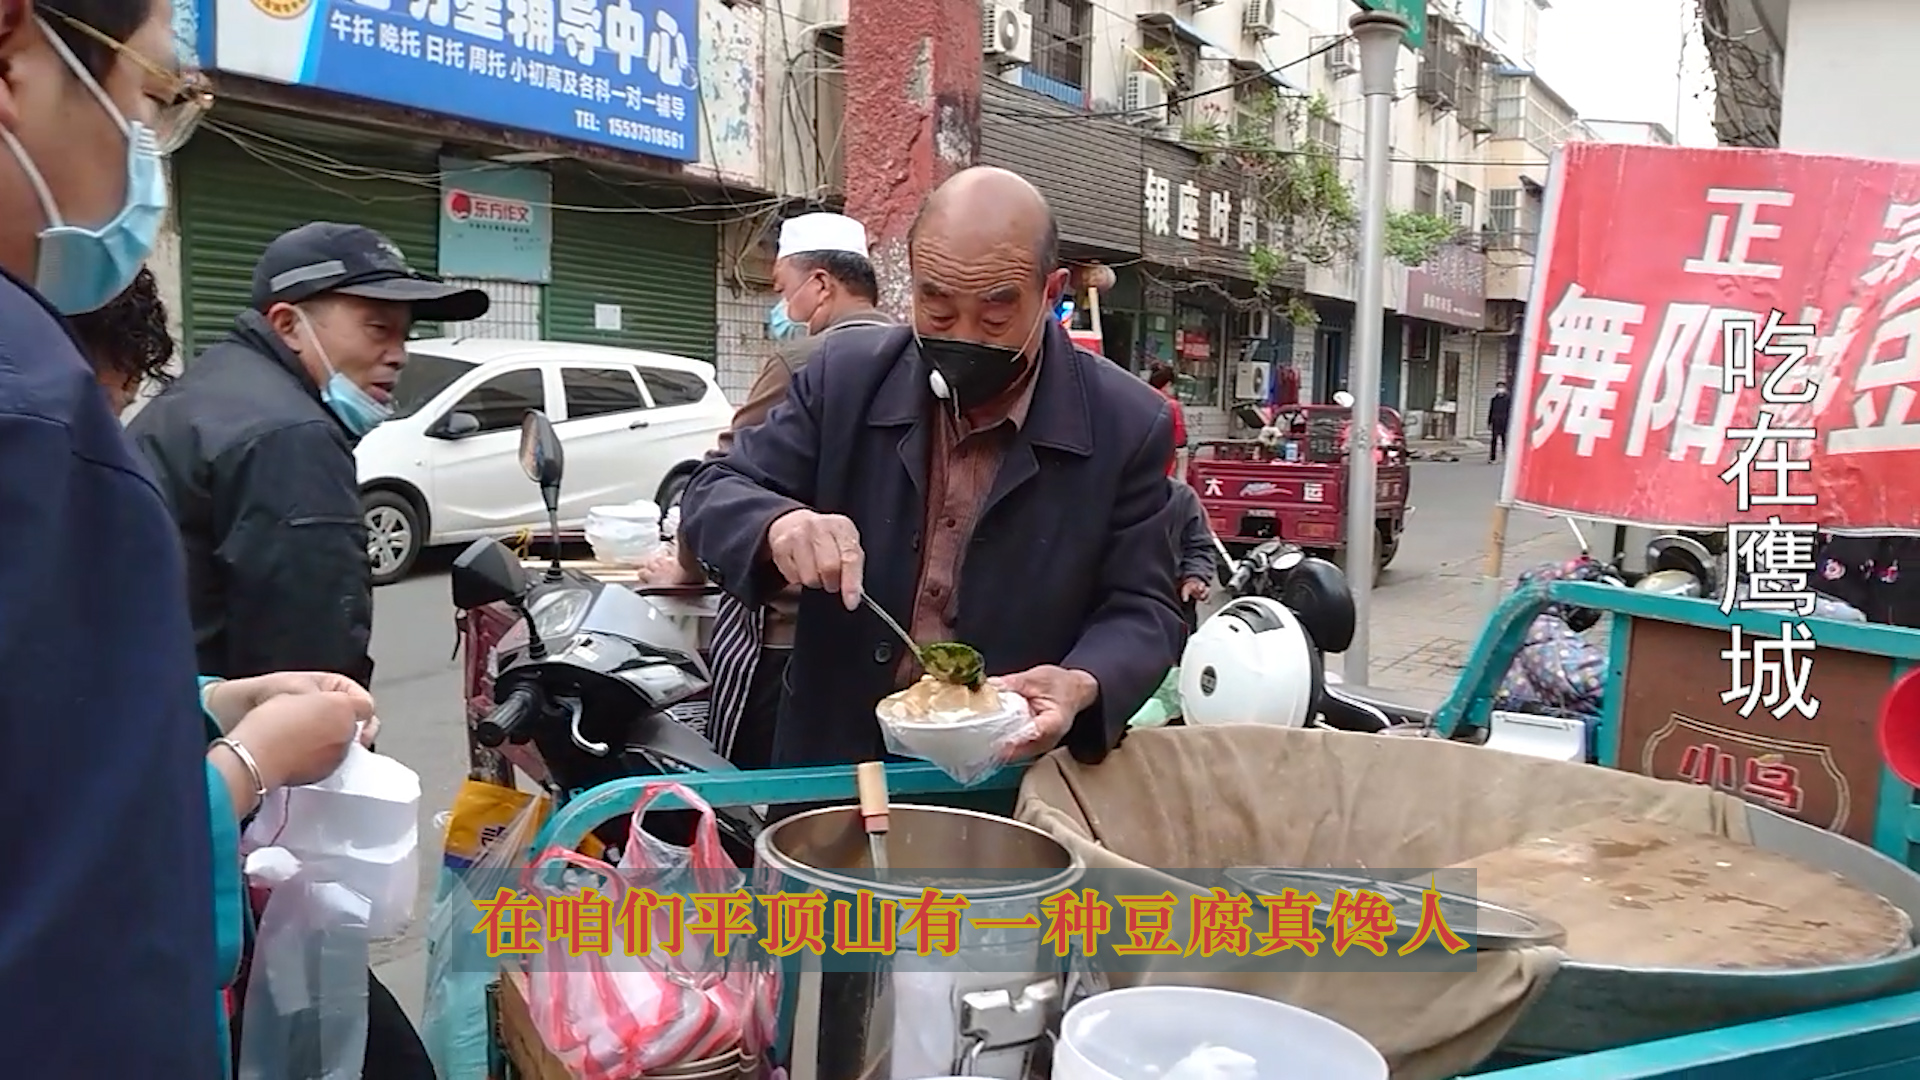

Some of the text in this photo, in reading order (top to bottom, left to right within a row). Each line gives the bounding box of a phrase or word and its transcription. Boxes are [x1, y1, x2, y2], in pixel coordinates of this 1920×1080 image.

[353, 0, 690, 87] 星辅导中心
[330, 9, 686, 121] 午托 晚托 日托 周托 小初高及各科一对一辅导
[574, 109, 685, 150] TEL: 15537518561
[474, 201, 530, 223] 东方作文
[1204, 478, 1224, 496] 大
